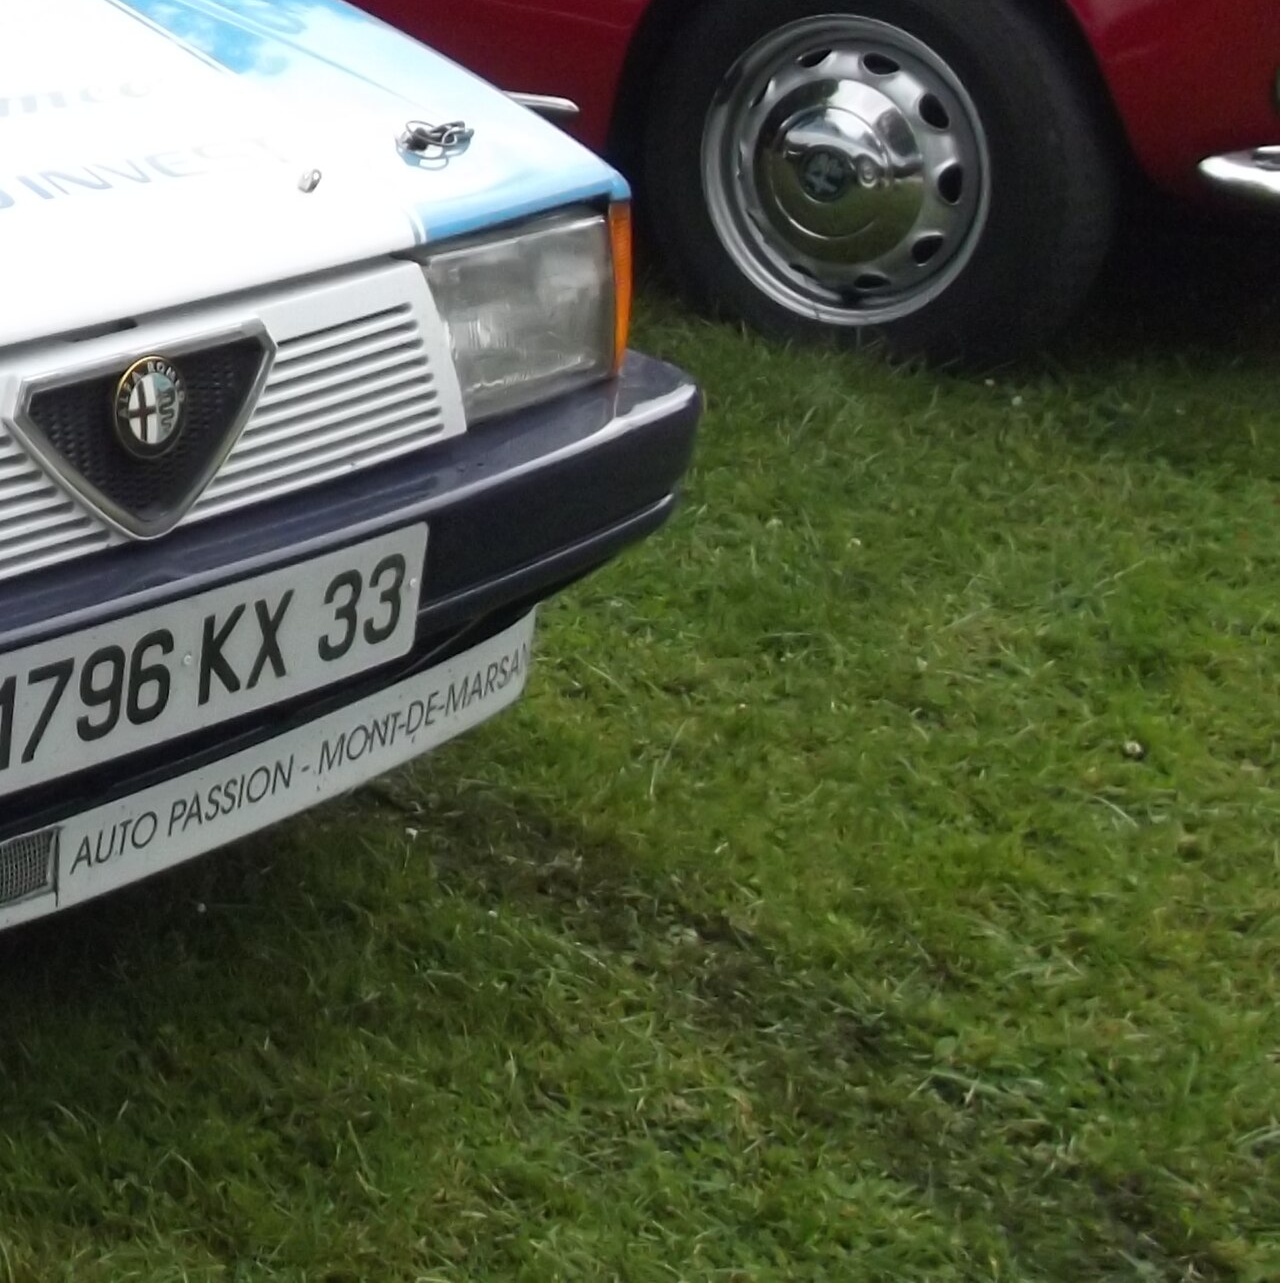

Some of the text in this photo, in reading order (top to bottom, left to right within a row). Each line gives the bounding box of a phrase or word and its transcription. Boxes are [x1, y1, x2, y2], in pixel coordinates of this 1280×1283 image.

[198, 590, 294, 706] KX
[318, 553, 407, 662] 33
[70, 810, 158, 875] AUTO
[167, 754, 295, 837] PASSION
